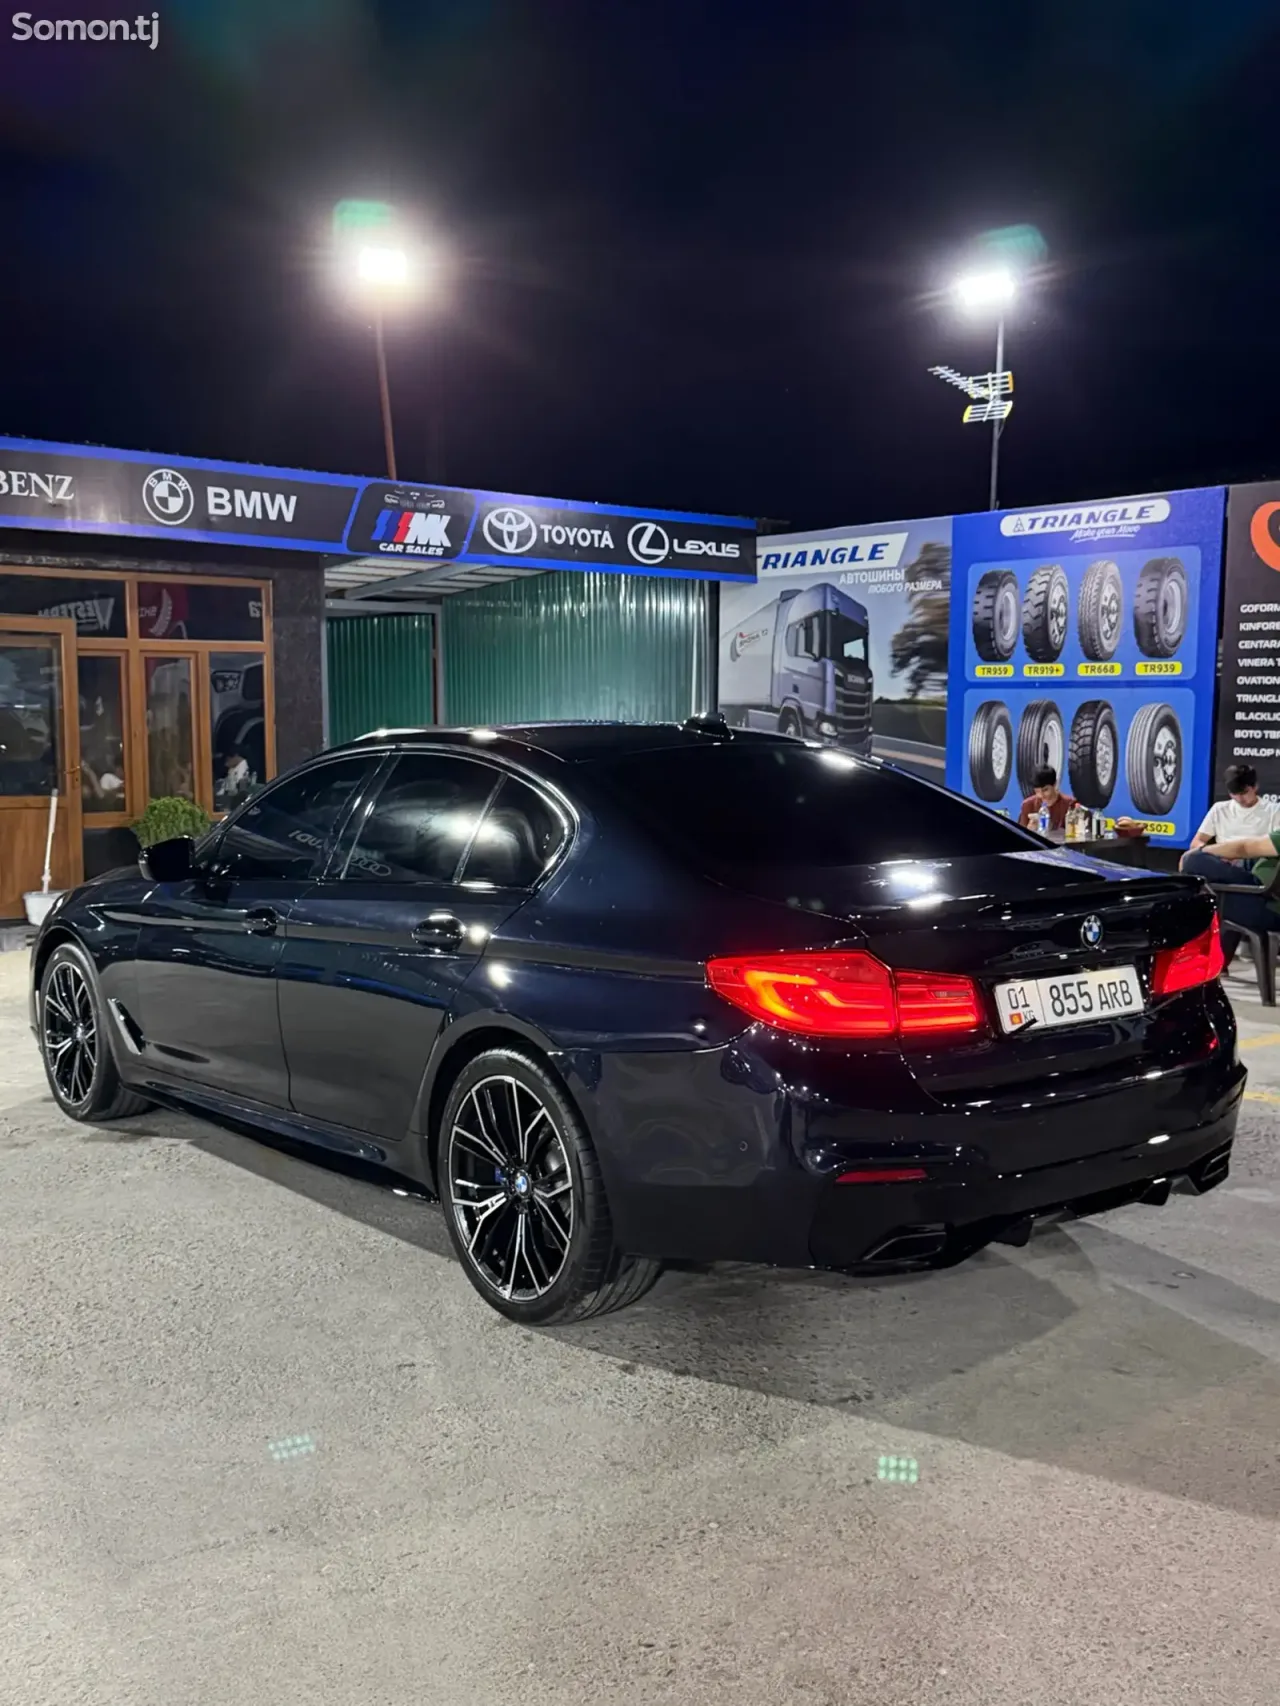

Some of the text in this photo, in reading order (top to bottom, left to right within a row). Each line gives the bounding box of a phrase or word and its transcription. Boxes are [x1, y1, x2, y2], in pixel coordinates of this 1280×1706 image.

[206, 486, 297, 523] BMW
[1028, 505, 1155, 530] TRIANGLE
[540, 524, 615, 549] TOYOTA
[379, 542, 444, 556] CAR SALES
[673, 538, 740, 558] LEXUS
[756, 543, 890, 570] RIANGLE
[839, 568, 905, 585] АВТОШИНЫ
[904, 580, 942, 592] РАЗМЕРА
[1142, 664, 1176, 673] TR939
[1237, 657, 1275, 667] VINERA
[981, 667, 1008, 675] TR959
[1084, 665, 1115, 674] TR668
[1236, 676, 1280, 685] OVATION
[1234, 729, 1262, 739] BOTO
[1233, 747, 1274, 757] DUNLOP
[1007, 979, 1134, 1018] 01 855 ARB
